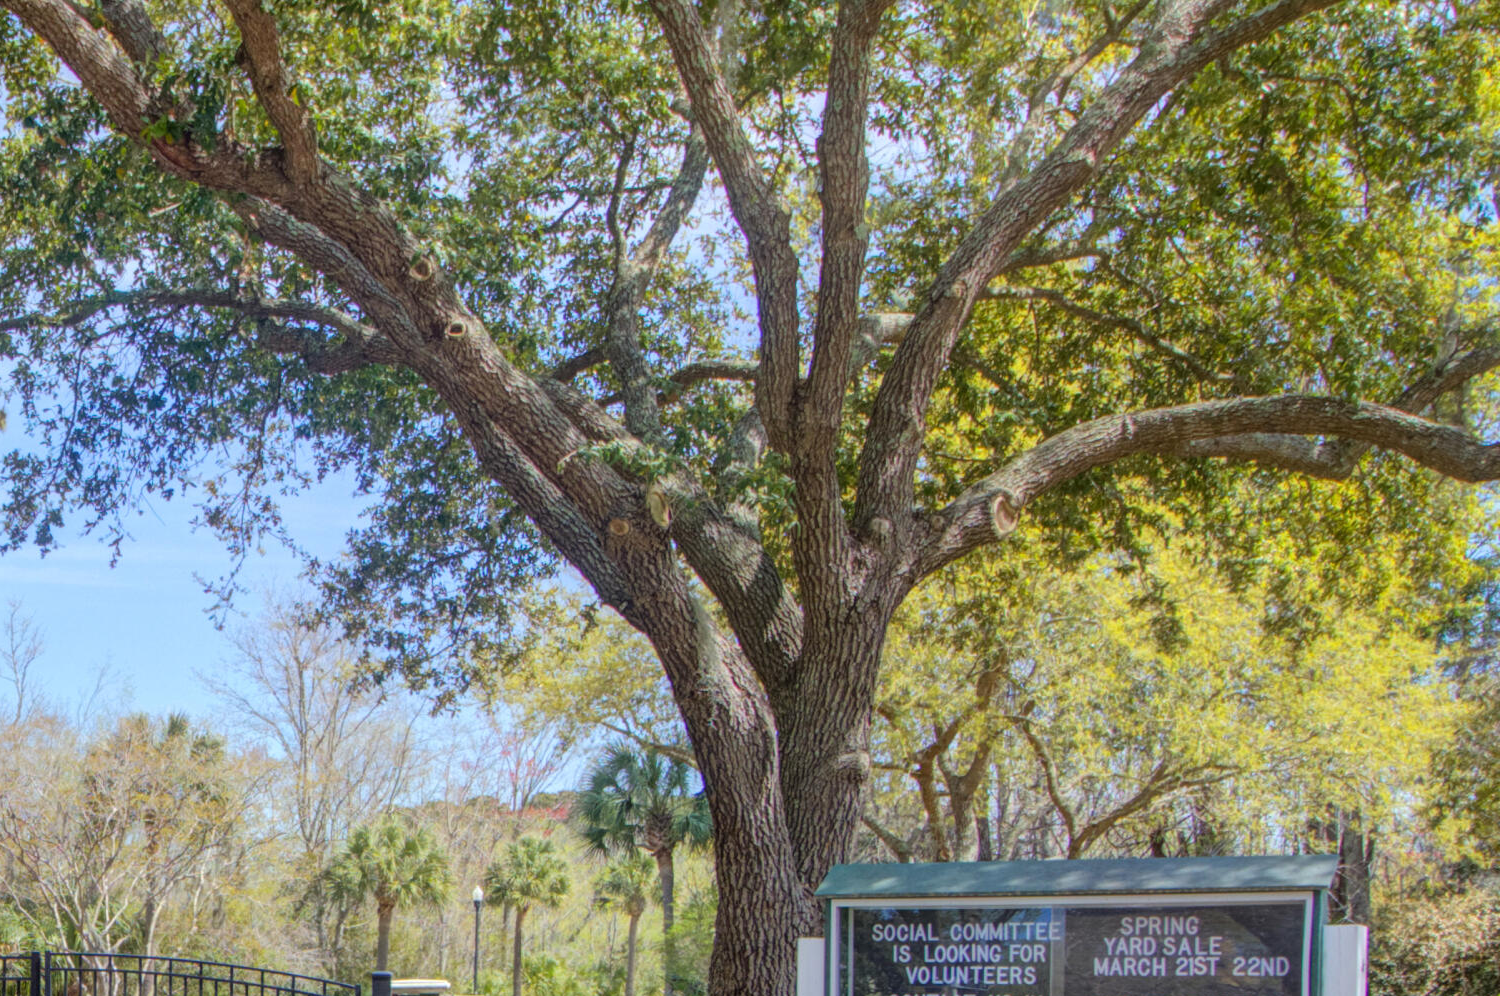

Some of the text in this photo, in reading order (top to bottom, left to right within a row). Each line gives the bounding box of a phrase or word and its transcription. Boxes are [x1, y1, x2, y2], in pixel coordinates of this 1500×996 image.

[871, 922, 1061, 941] SOCIAL COMMITTEE
[1120, 916, 1199, 936] SPRING
[893, 944, 1047, 963] IS LOOKING FOR
[1104, 937, 1223, 956] YARD SALE
[905, 966, 1037, 985] VOLUNTEERS
[1093, 956, 1291, 977] MARCH 21ST 22ND
